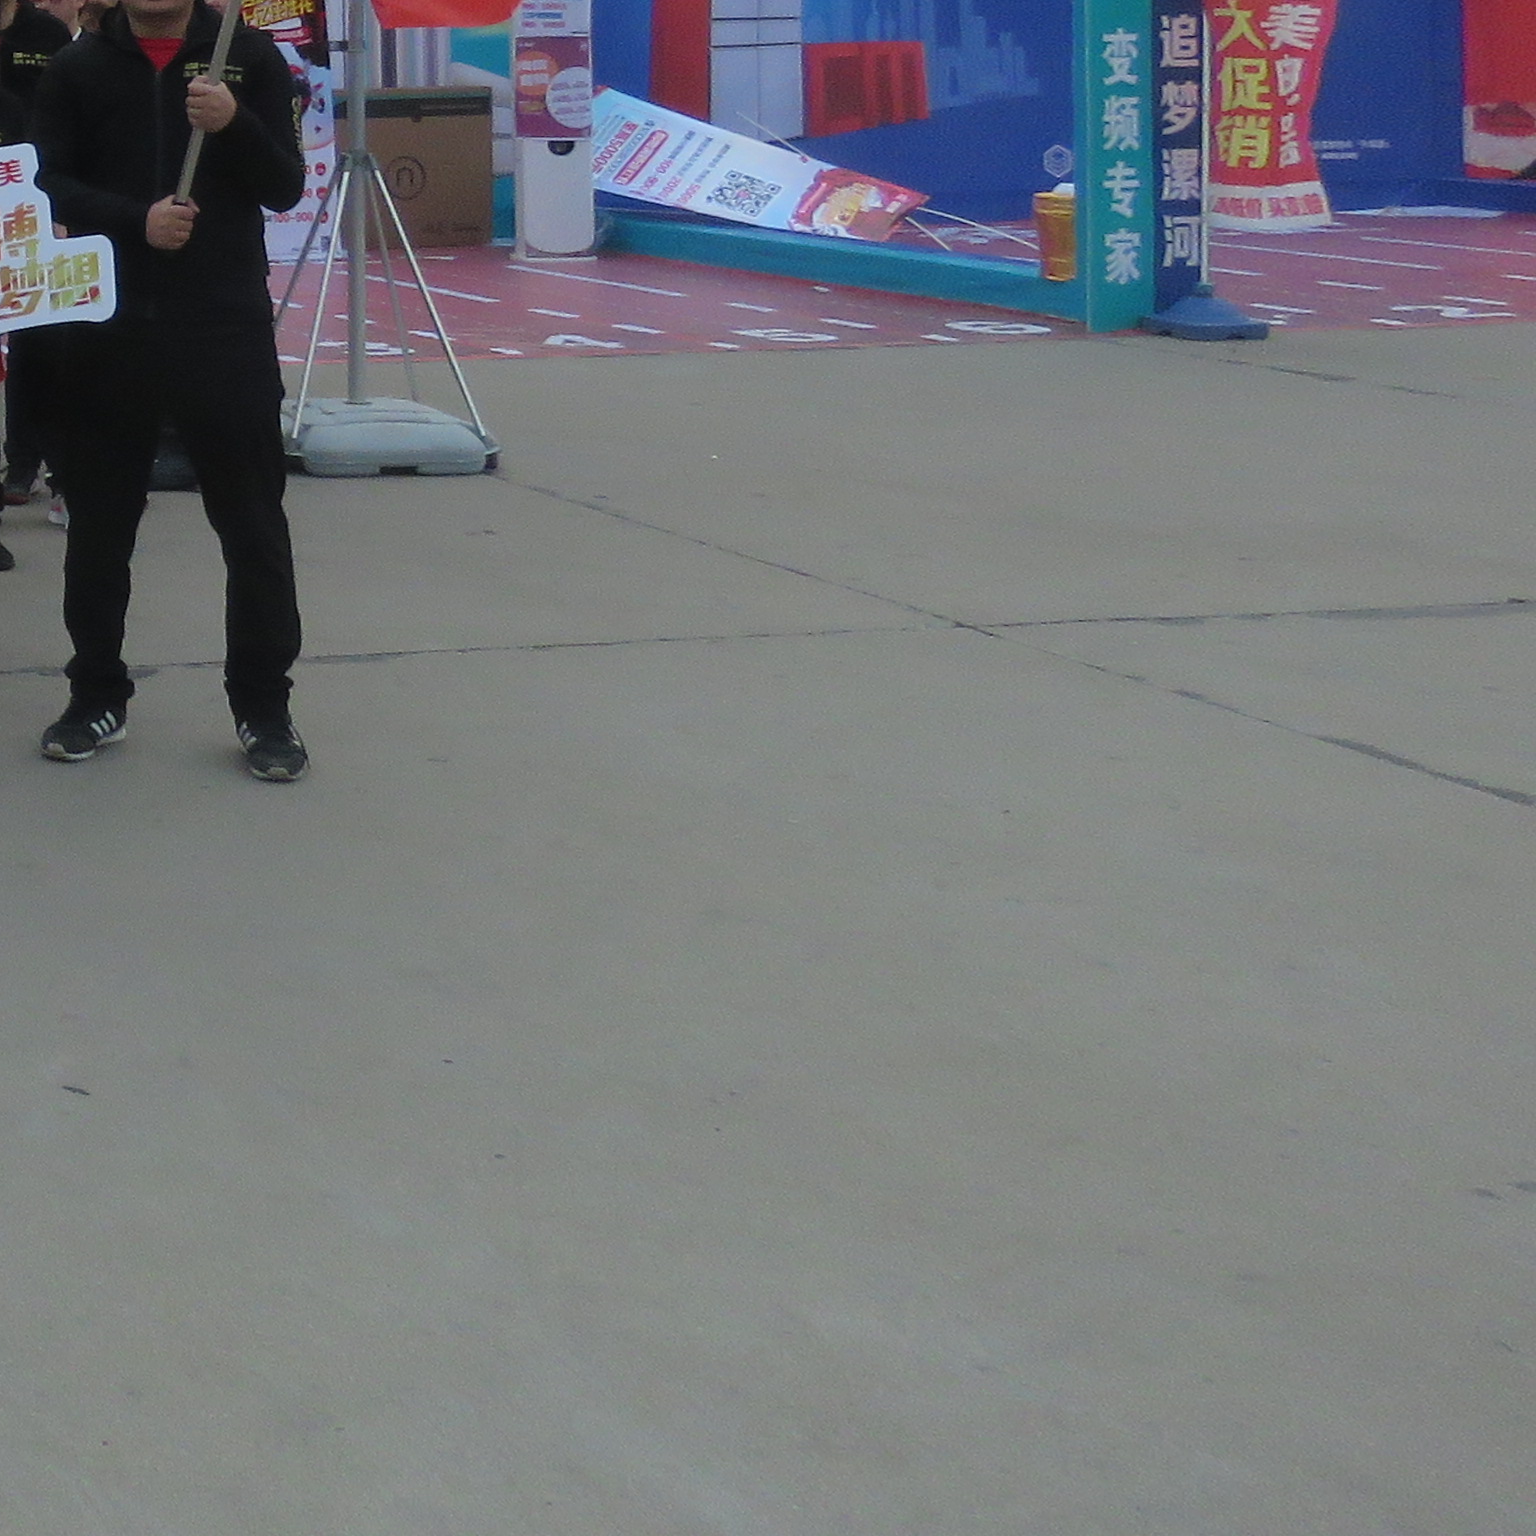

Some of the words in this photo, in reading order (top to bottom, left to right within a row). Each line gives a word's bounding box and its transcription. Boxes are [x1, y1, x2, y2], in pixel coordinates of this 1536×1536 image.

[1100, 27, 1142, 287] 变频专家
[1158, 13, 1204, 269] 追梦漯河
